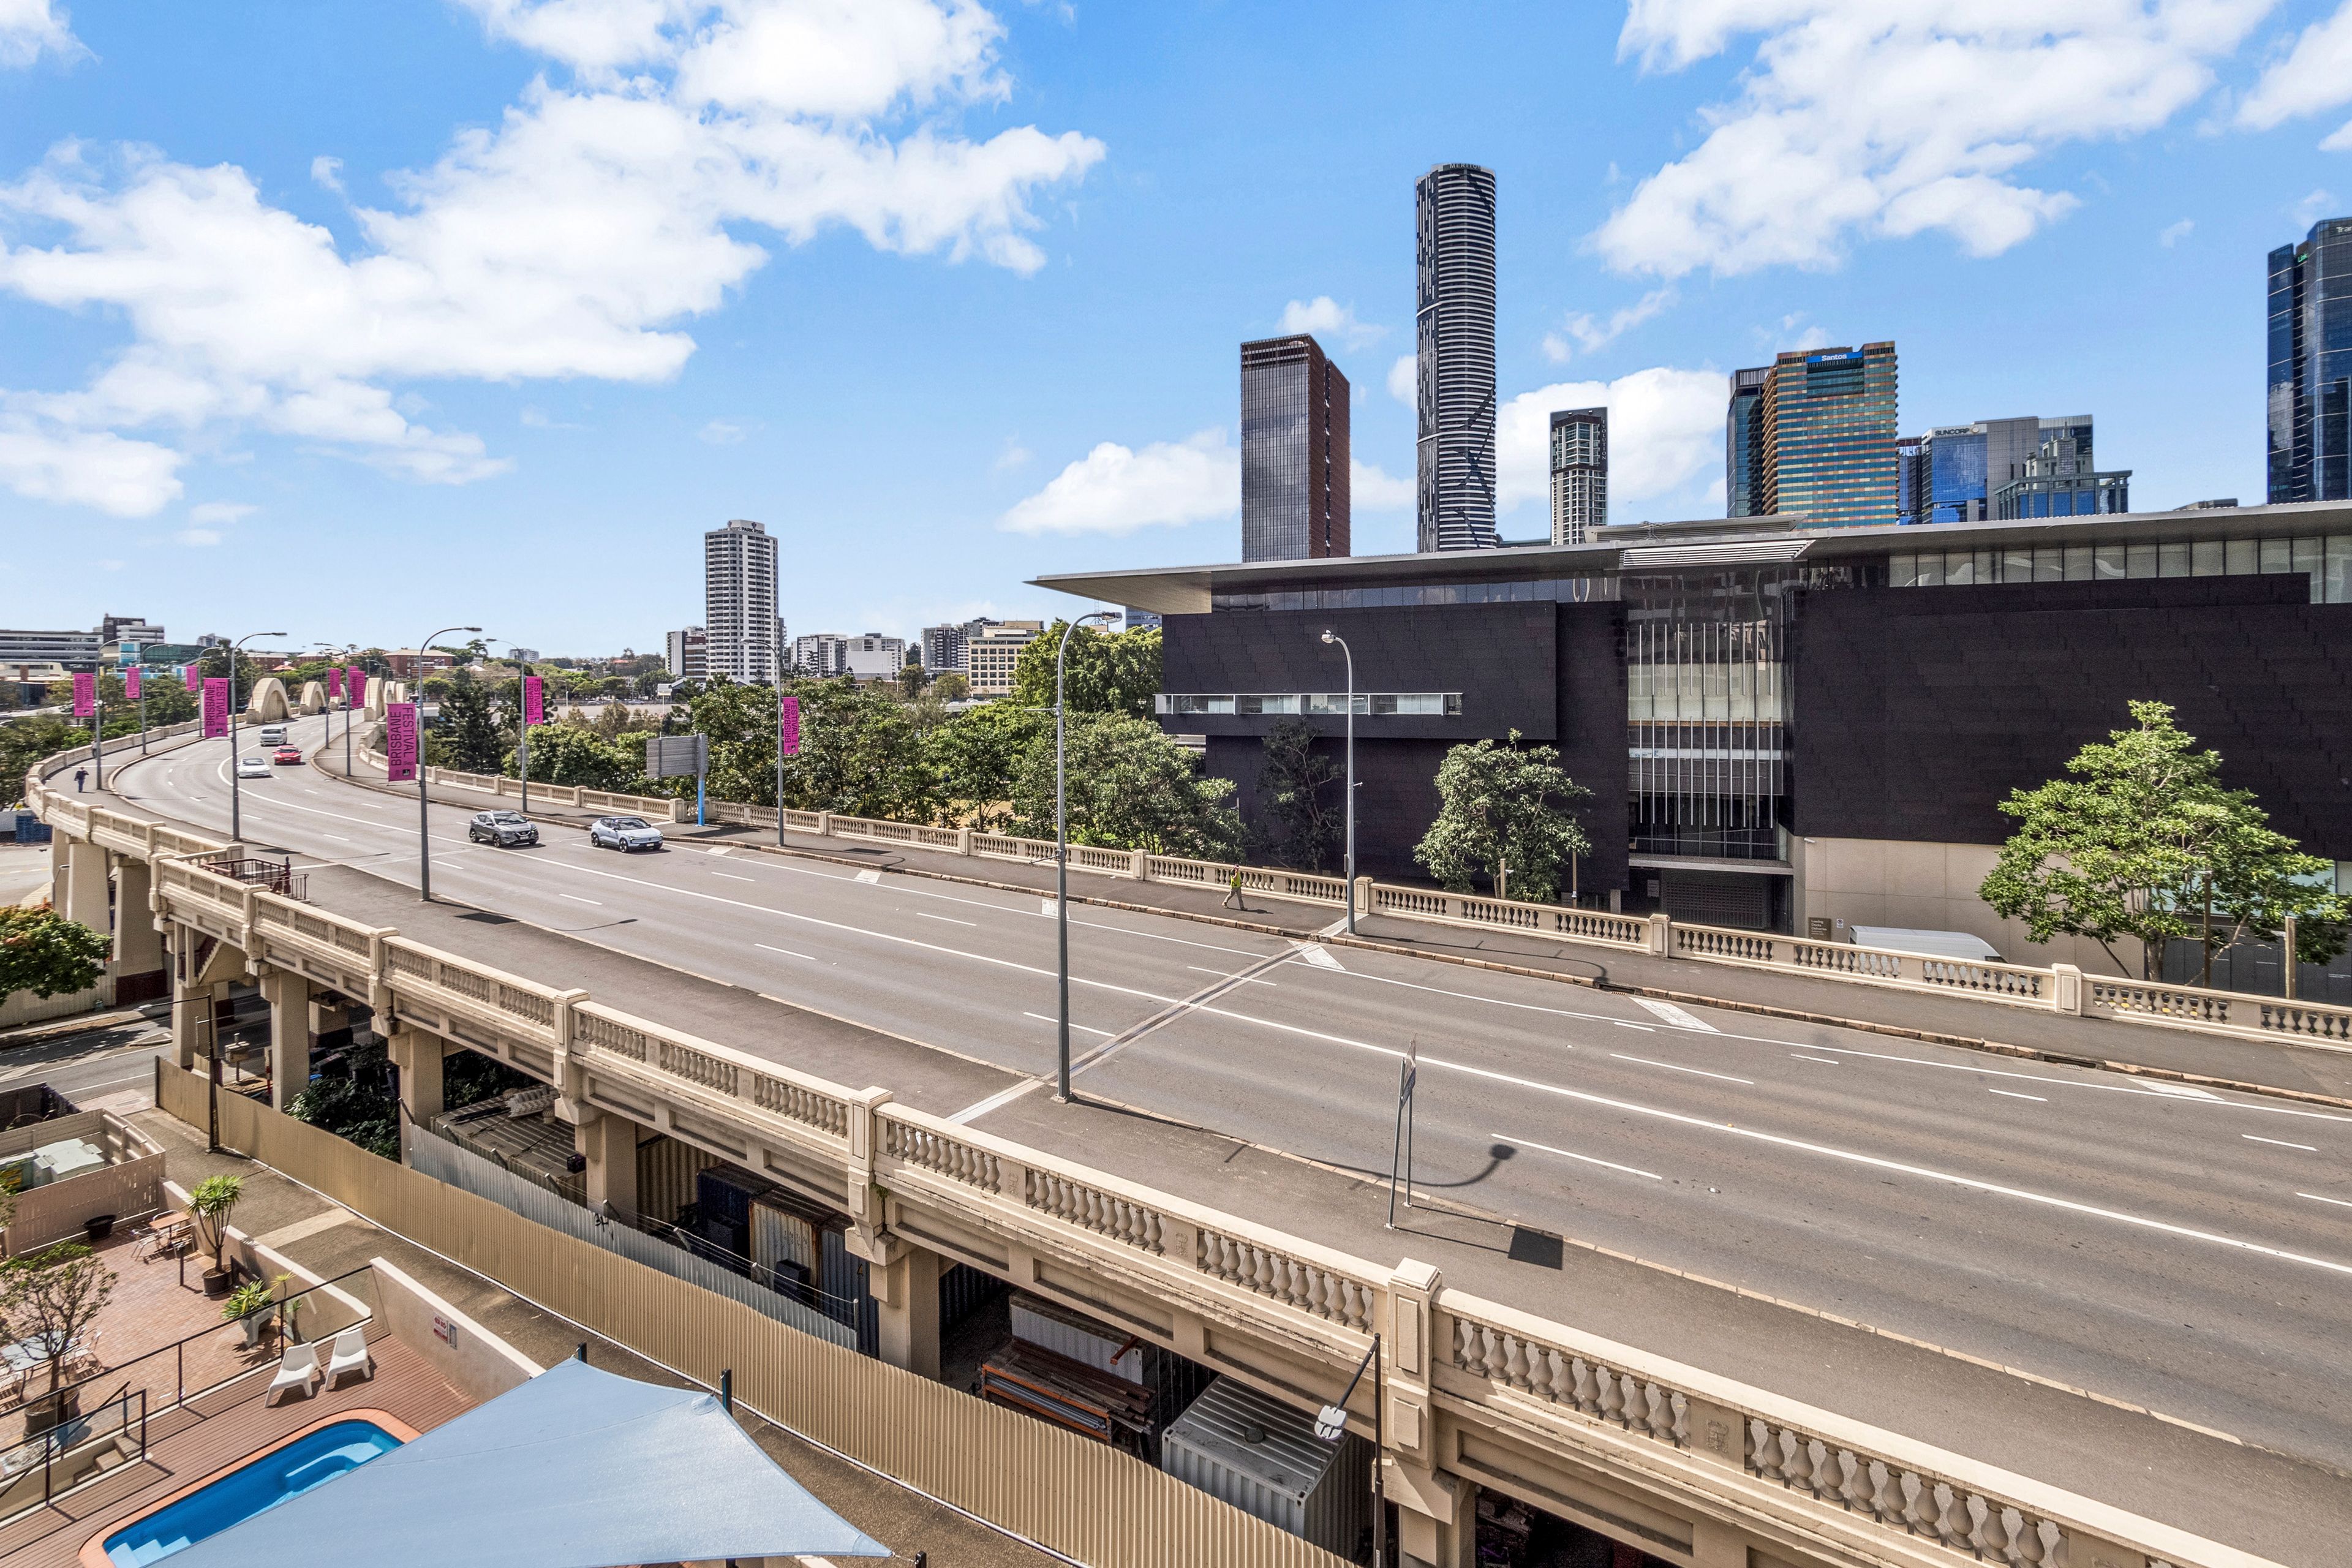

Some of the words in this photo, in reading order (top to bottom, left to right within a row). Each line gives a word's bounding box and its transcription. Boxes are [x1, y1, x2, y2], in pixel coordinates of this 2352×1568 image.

[206, 685, 215, 726] BRISBANE
[216, 681, 226, 719] FESTIVAL
[390, 712, 402, 766] BRISBANE
[402, 707, 414, 758] FESTIVAL
